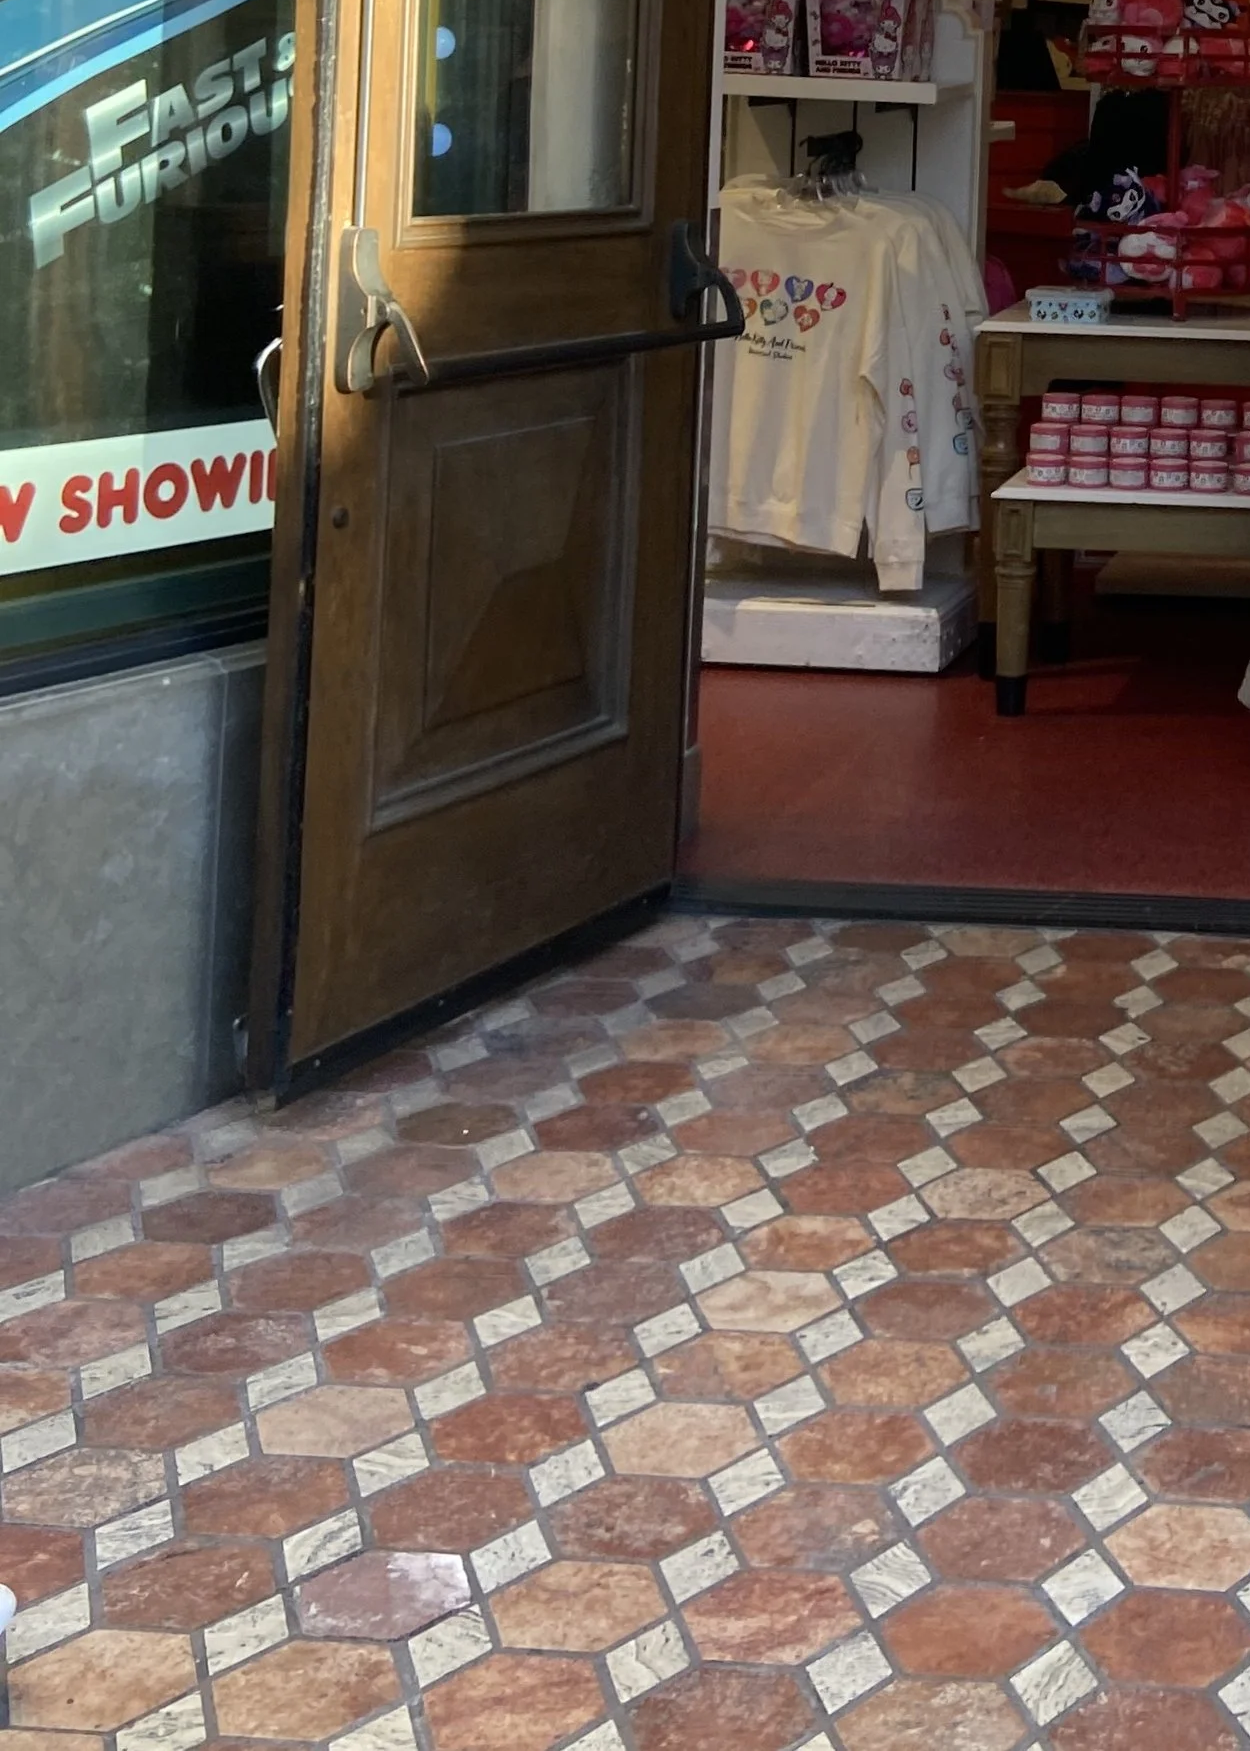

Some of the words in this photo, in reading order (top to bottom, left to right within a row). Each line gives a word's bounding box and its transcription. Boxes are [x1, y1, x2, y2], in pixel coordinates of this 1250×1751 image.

[29, 73, 294, 270] FURIOU
[86, 37, 267, 180] FAST
[59, 449, 277, 534] SHOWI
